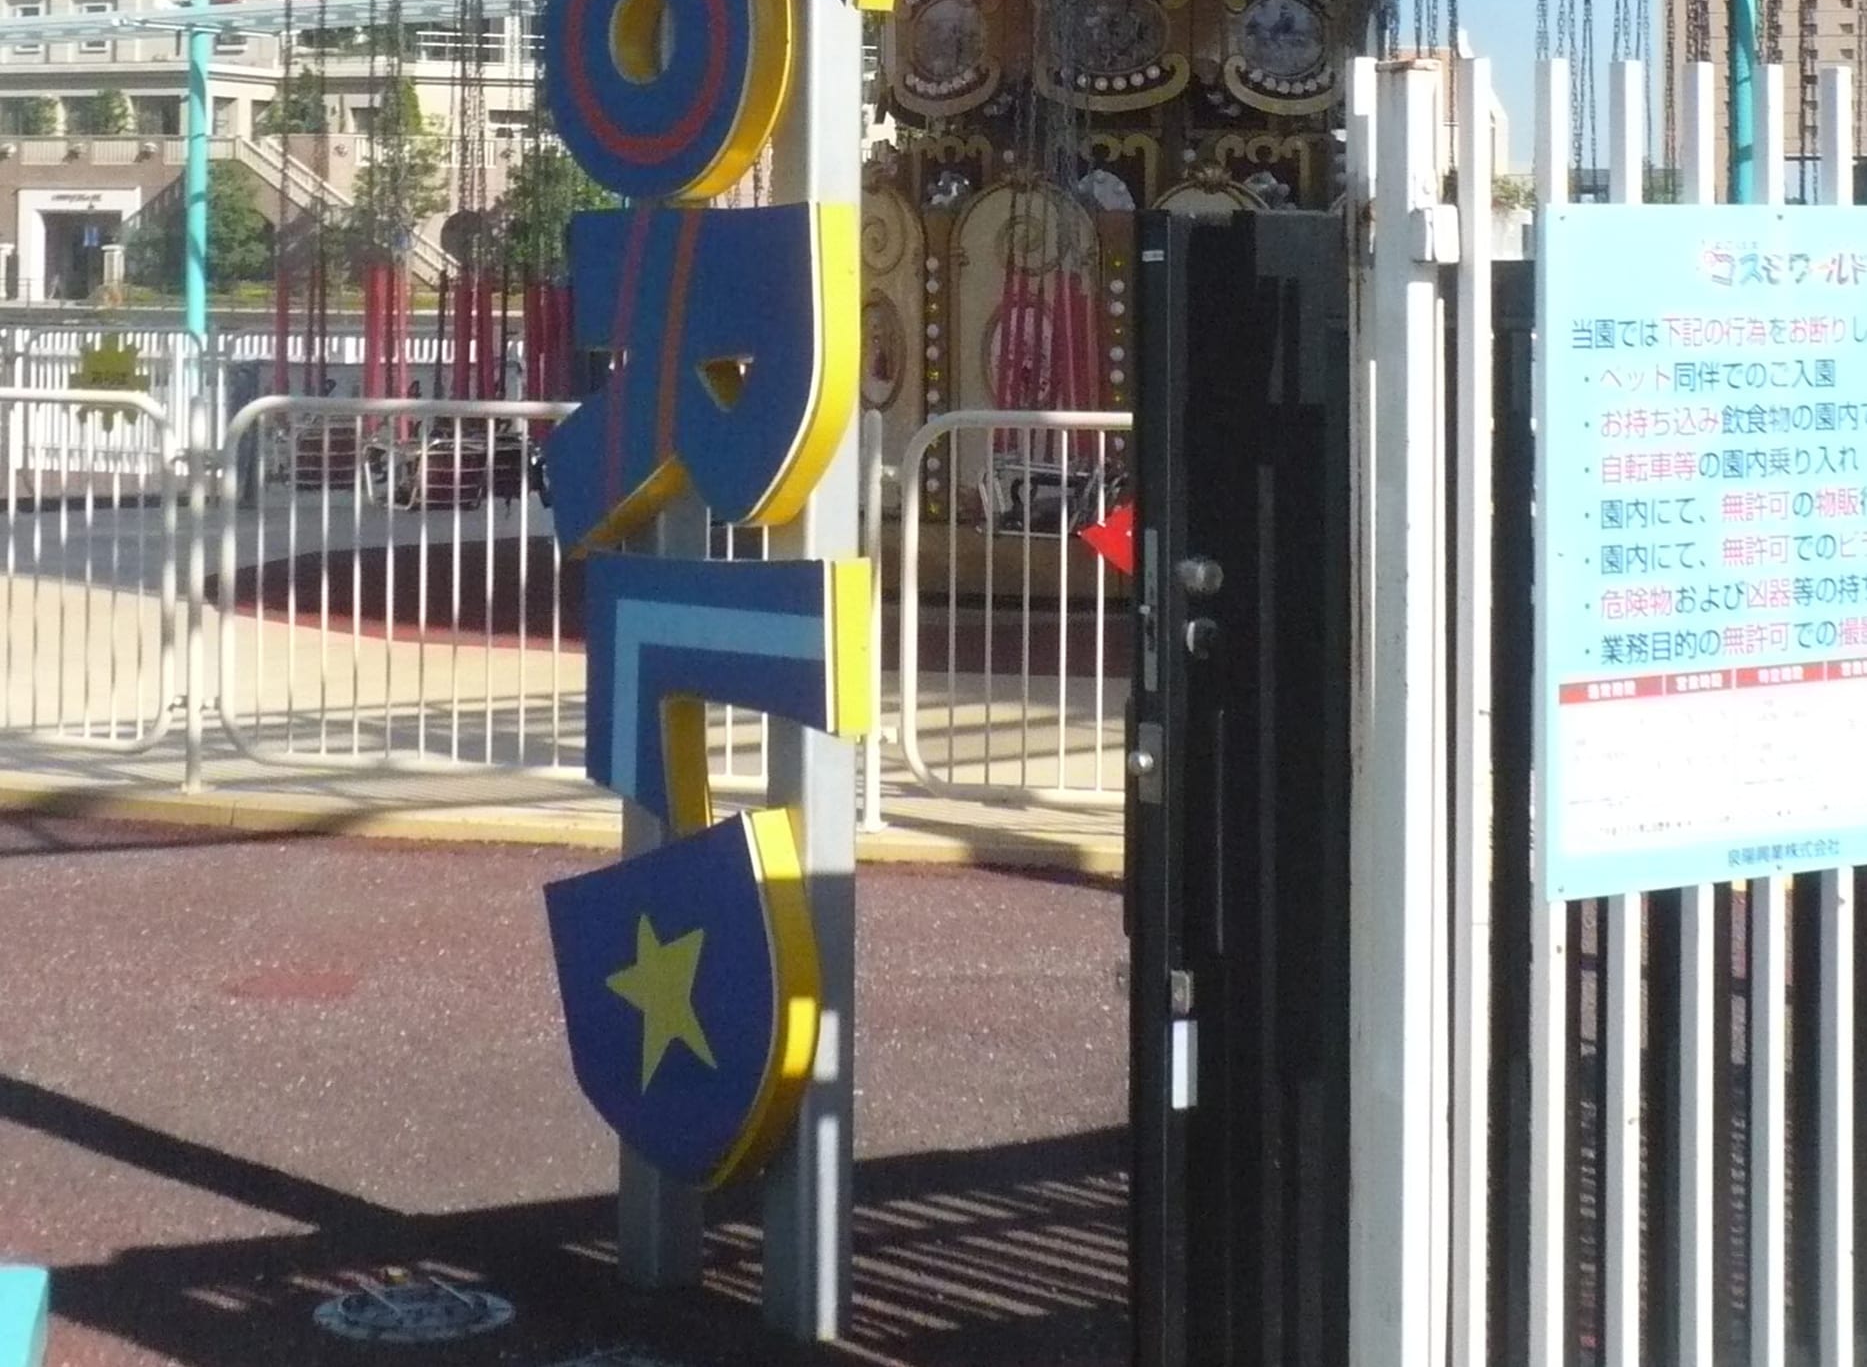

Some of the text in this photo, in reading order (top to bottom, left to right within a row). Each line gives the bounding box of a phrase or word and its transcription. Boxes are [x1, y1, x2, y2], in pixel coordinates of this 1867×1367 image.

[1602, 446, 1859, 485] 自転車等の園内乗り入れ
[1600, 576, 1867, 621] 危険物および凶器等の持
